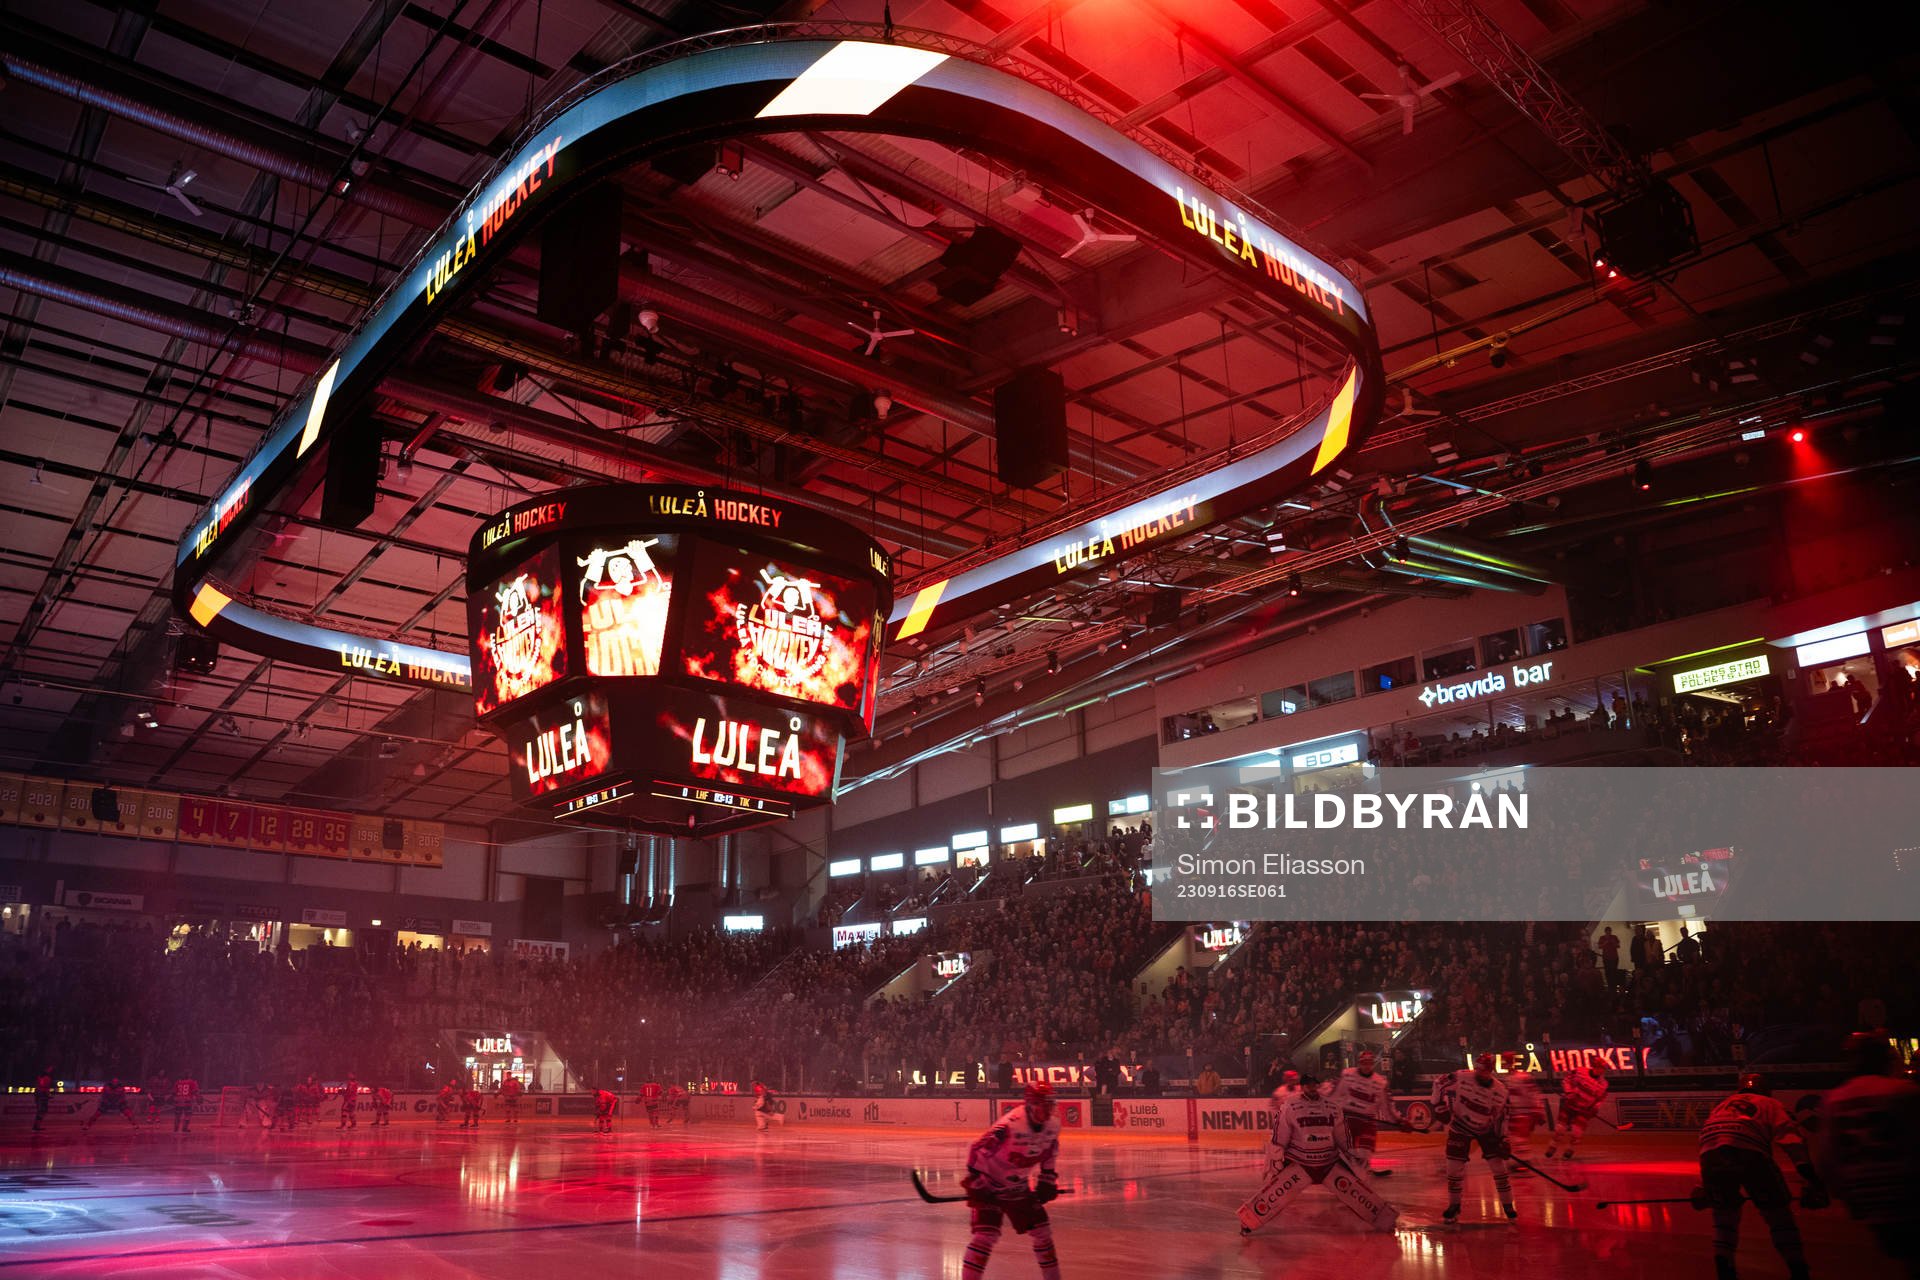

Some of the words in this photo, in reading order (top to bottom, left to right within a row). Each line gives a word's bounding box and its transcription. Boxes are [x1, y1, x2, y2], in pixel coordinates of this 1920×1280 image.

[426, 209, 476, 306] LULEÅ
[482, 135, 562, 247] HOCKEY
[1176, 186, 1257, 268] LULEÅ
[1260, 236, 1344, 315] HOCKEY
[649, 490, 708, 518] LULEÅ
[714, 498, 782, 528] HOCKEY
[483, 511, 511, 550] LULEÅ
[514, 502, 567, 534] HOCKEY
[1054, 519, 1115, 575] LULEÅ
[1119, 494, 1198, 550] HOCKEY
[870, 547, 889, 577] LULE
[341, 643, 401, 677] LULEÅ
[408, 655, 472, 687] HOCKE
[1435, 671, 1506, 705] bravida
[1512, 661, 1553, 688] bar
[526, 701, 592, 784] LULEÅ
[692, 717, 801, 779] LULEÅ
[28, 792, 57, 807] 2021
[70, 796, 94, 809] 201
[147, 805, 174, 820] 2016
[192, 807, 204, 828] 4
[228, 811, 240, 831] 7
[260, 815, 278, 836] 12
[292, 819, 314, 839] 28
[324, 822, 346, 843] 35
[1653, 862, 1716, 898] LULEÅ
[1203, 922, 1243, 949] LULEÅ
[1371, 992, 1424, 1026] LULEÅ
[475, 1033, 513, 1053] LULEÅ
[1466, 1042, 1543, 1074] LLEÅ
[1129, 1103, 1158, 1115] Luleå
[1130, 1116, 1165, 1128] Energi
[1202, 1110, 1253, 1130] NIEMI
[1267, 1174, 1301, 1204] COOR
[1350, 1189, 1380, 1216] COOR
